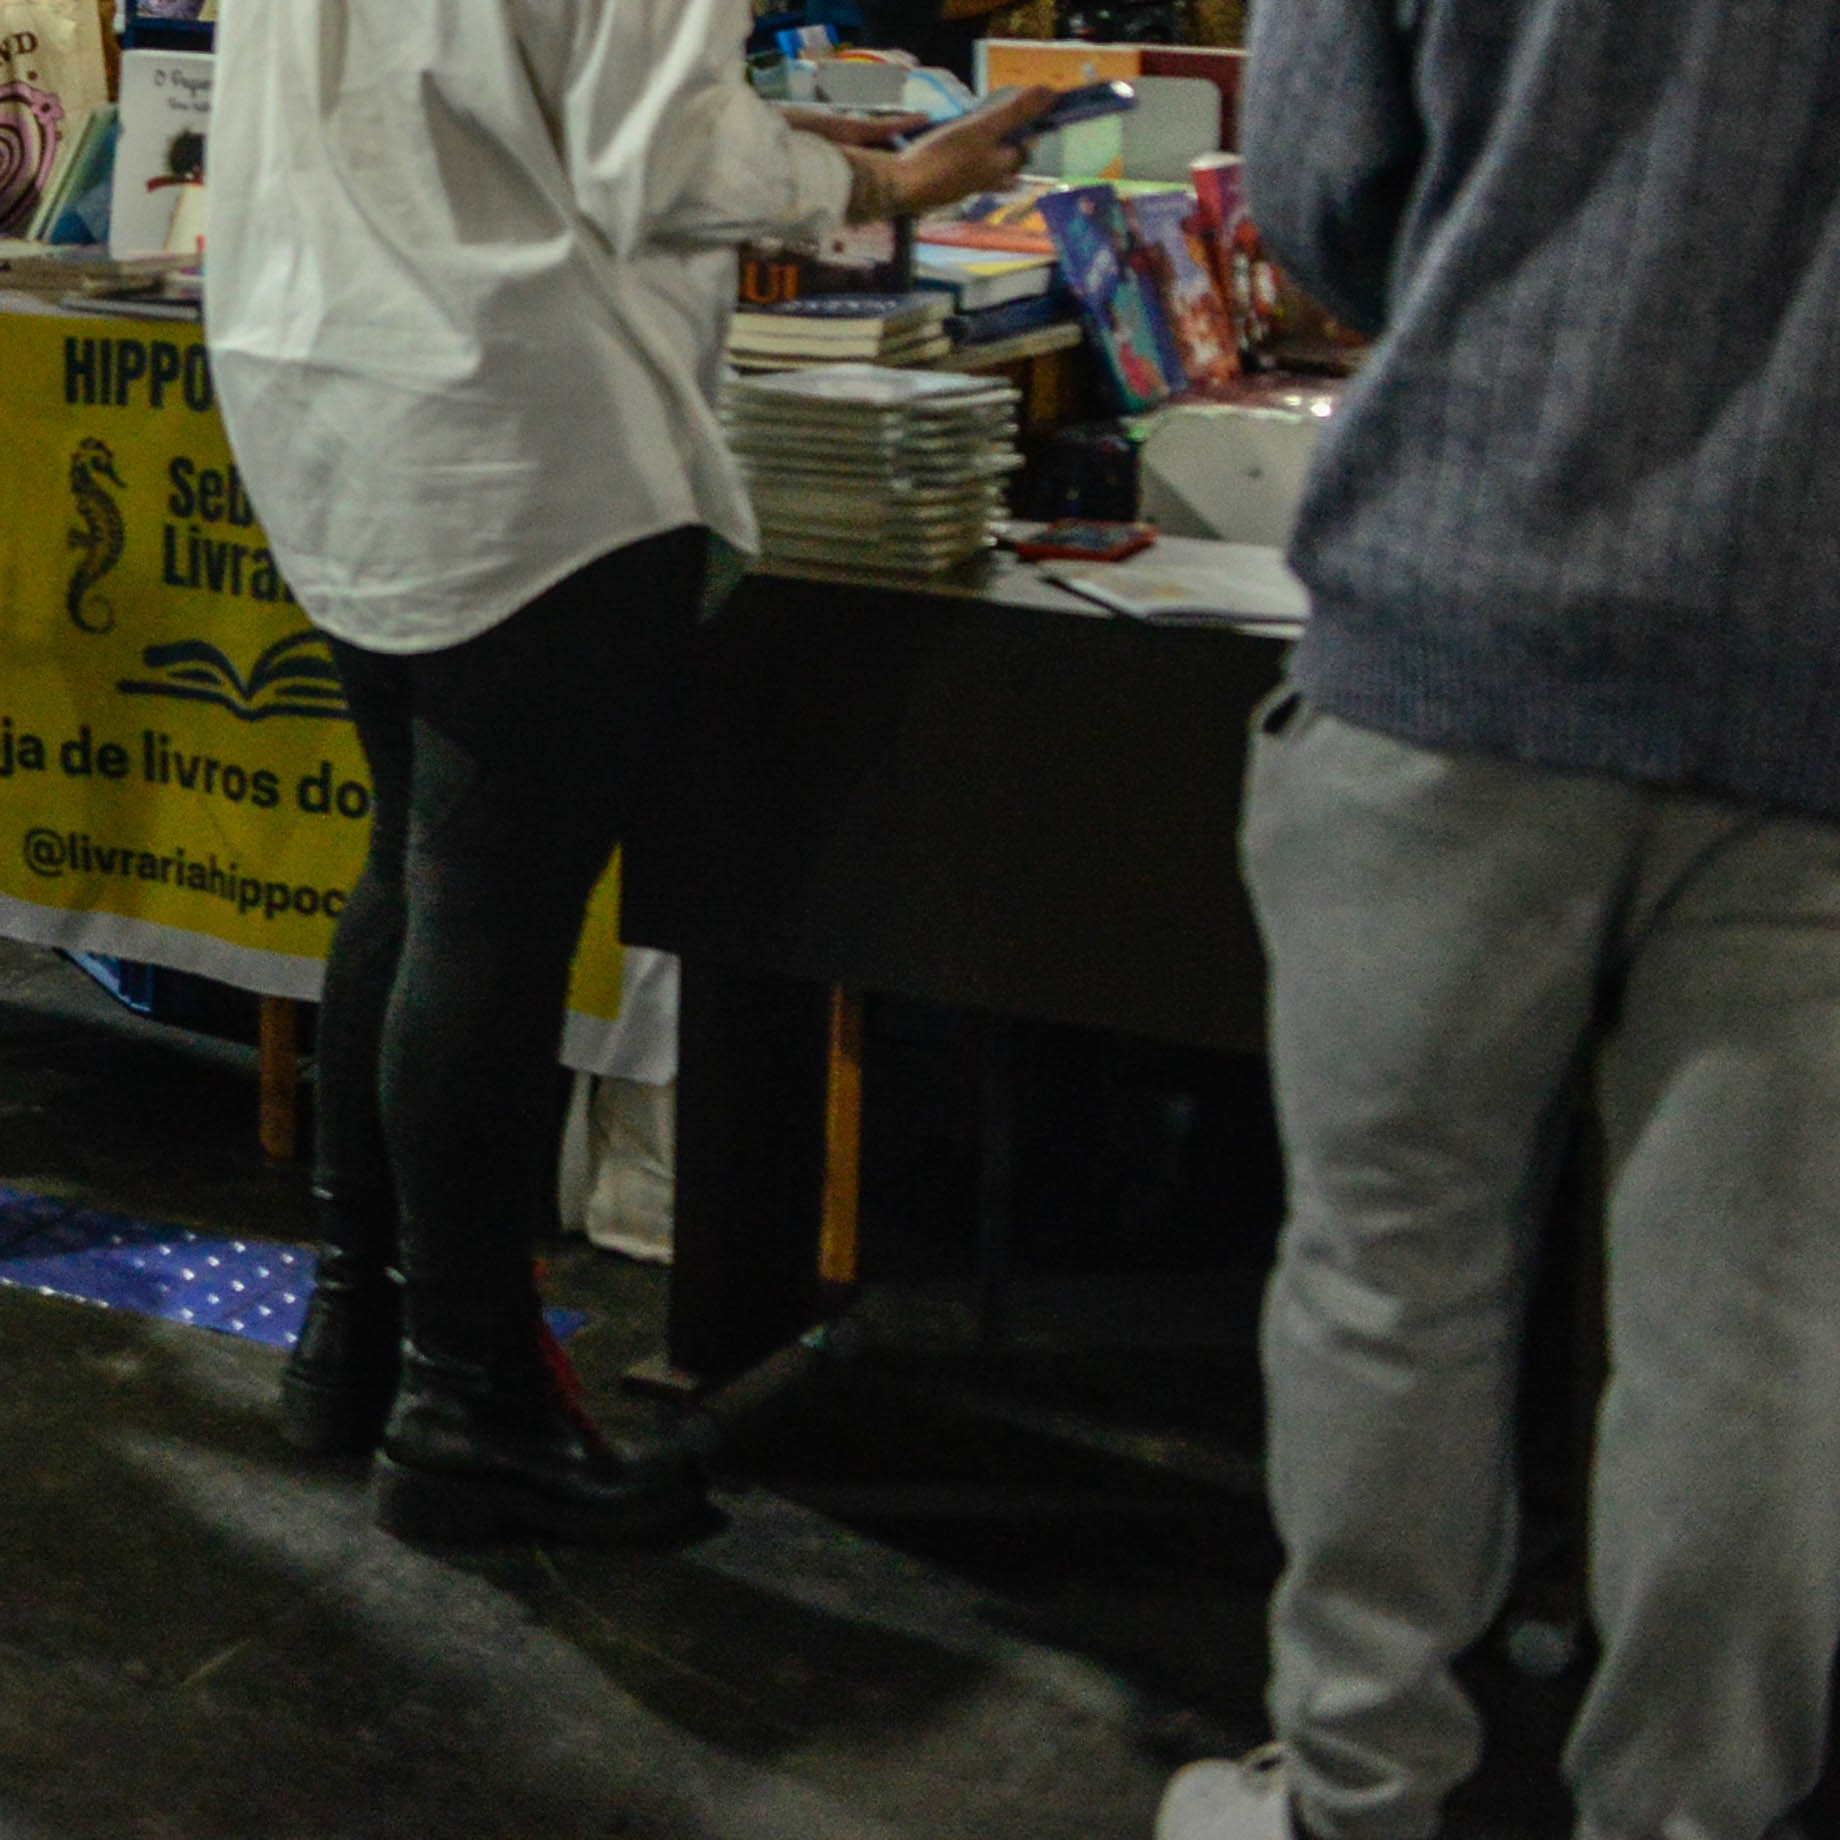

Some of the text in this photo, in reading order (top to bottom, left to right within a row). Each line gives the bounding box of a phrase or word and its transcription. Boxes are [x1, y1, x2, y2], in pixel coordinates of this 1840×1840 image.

[64, 336, 215, 414] HIPPO
[60, 723, 130, 779] de
[143, 729, 280, 809] livros
